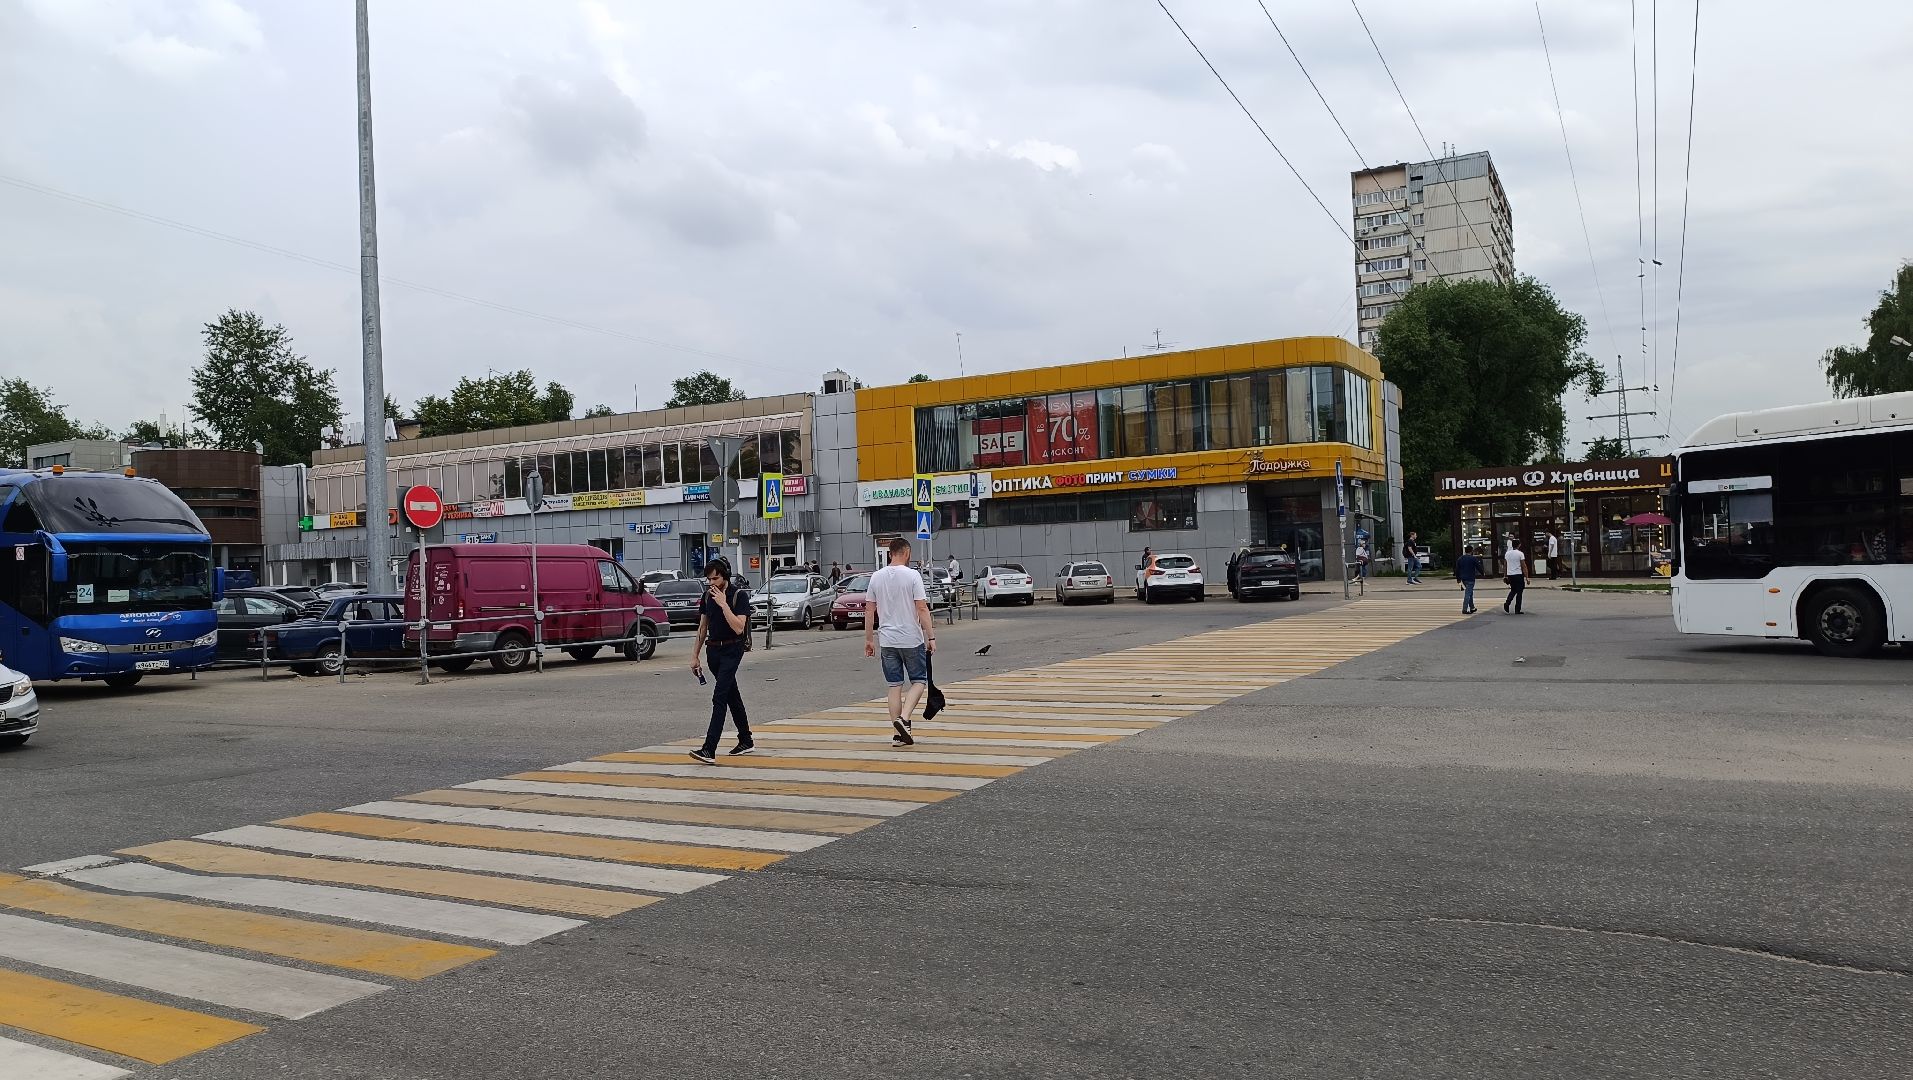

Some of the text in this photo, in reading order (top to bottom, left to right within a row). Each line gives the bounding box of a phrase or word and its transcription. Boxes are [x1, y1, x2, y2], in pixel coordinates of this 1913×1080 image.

[981, 436, 1016, 450] SALE
[1042, 446, 1085, 458] ДИСКОНТ
[1249, 459, 1311, 473] Подружка
[1128, 467, 1177, 481] СУМКИ
[1445, 468, 1640, 491] Пекарня Хлебница
[992, 475, 1053, 493] ОПТИКА
[635, 525, 651, 534] ВТБ
[465, 535, 480, 544] ВТБ
[78, 587, 93, 598] 24
[133, 642, 173, 651] HIGER
